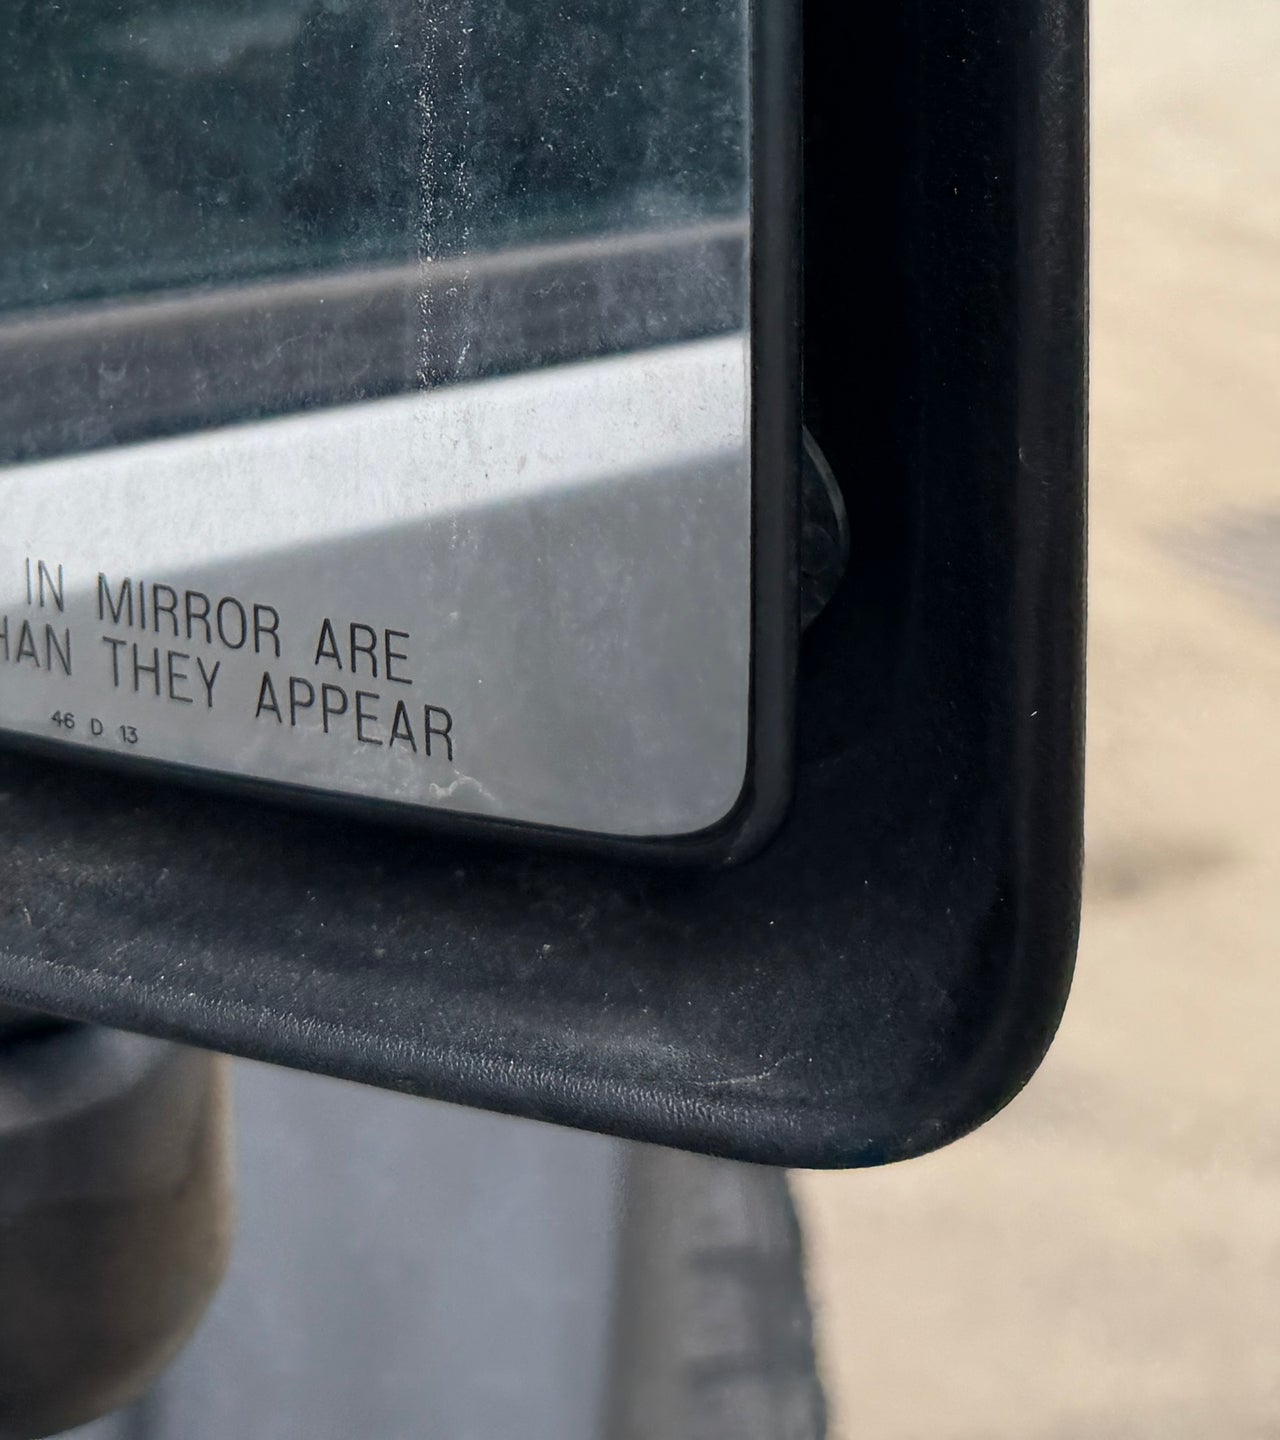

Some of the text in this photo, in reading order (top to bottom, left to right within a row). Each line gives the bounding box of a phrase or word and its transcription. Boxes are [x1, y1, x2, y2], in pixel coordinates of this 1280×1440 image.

[25, 557, 65, 612] IN
[98, 571, 281, 658] MIRROR
[314, 617, 413, 685] ARE
[51, 710, 139, 744] 46 D 13
[102, 636, 220, 708] THEY
[255, 671, 453, 762] APPEAR
